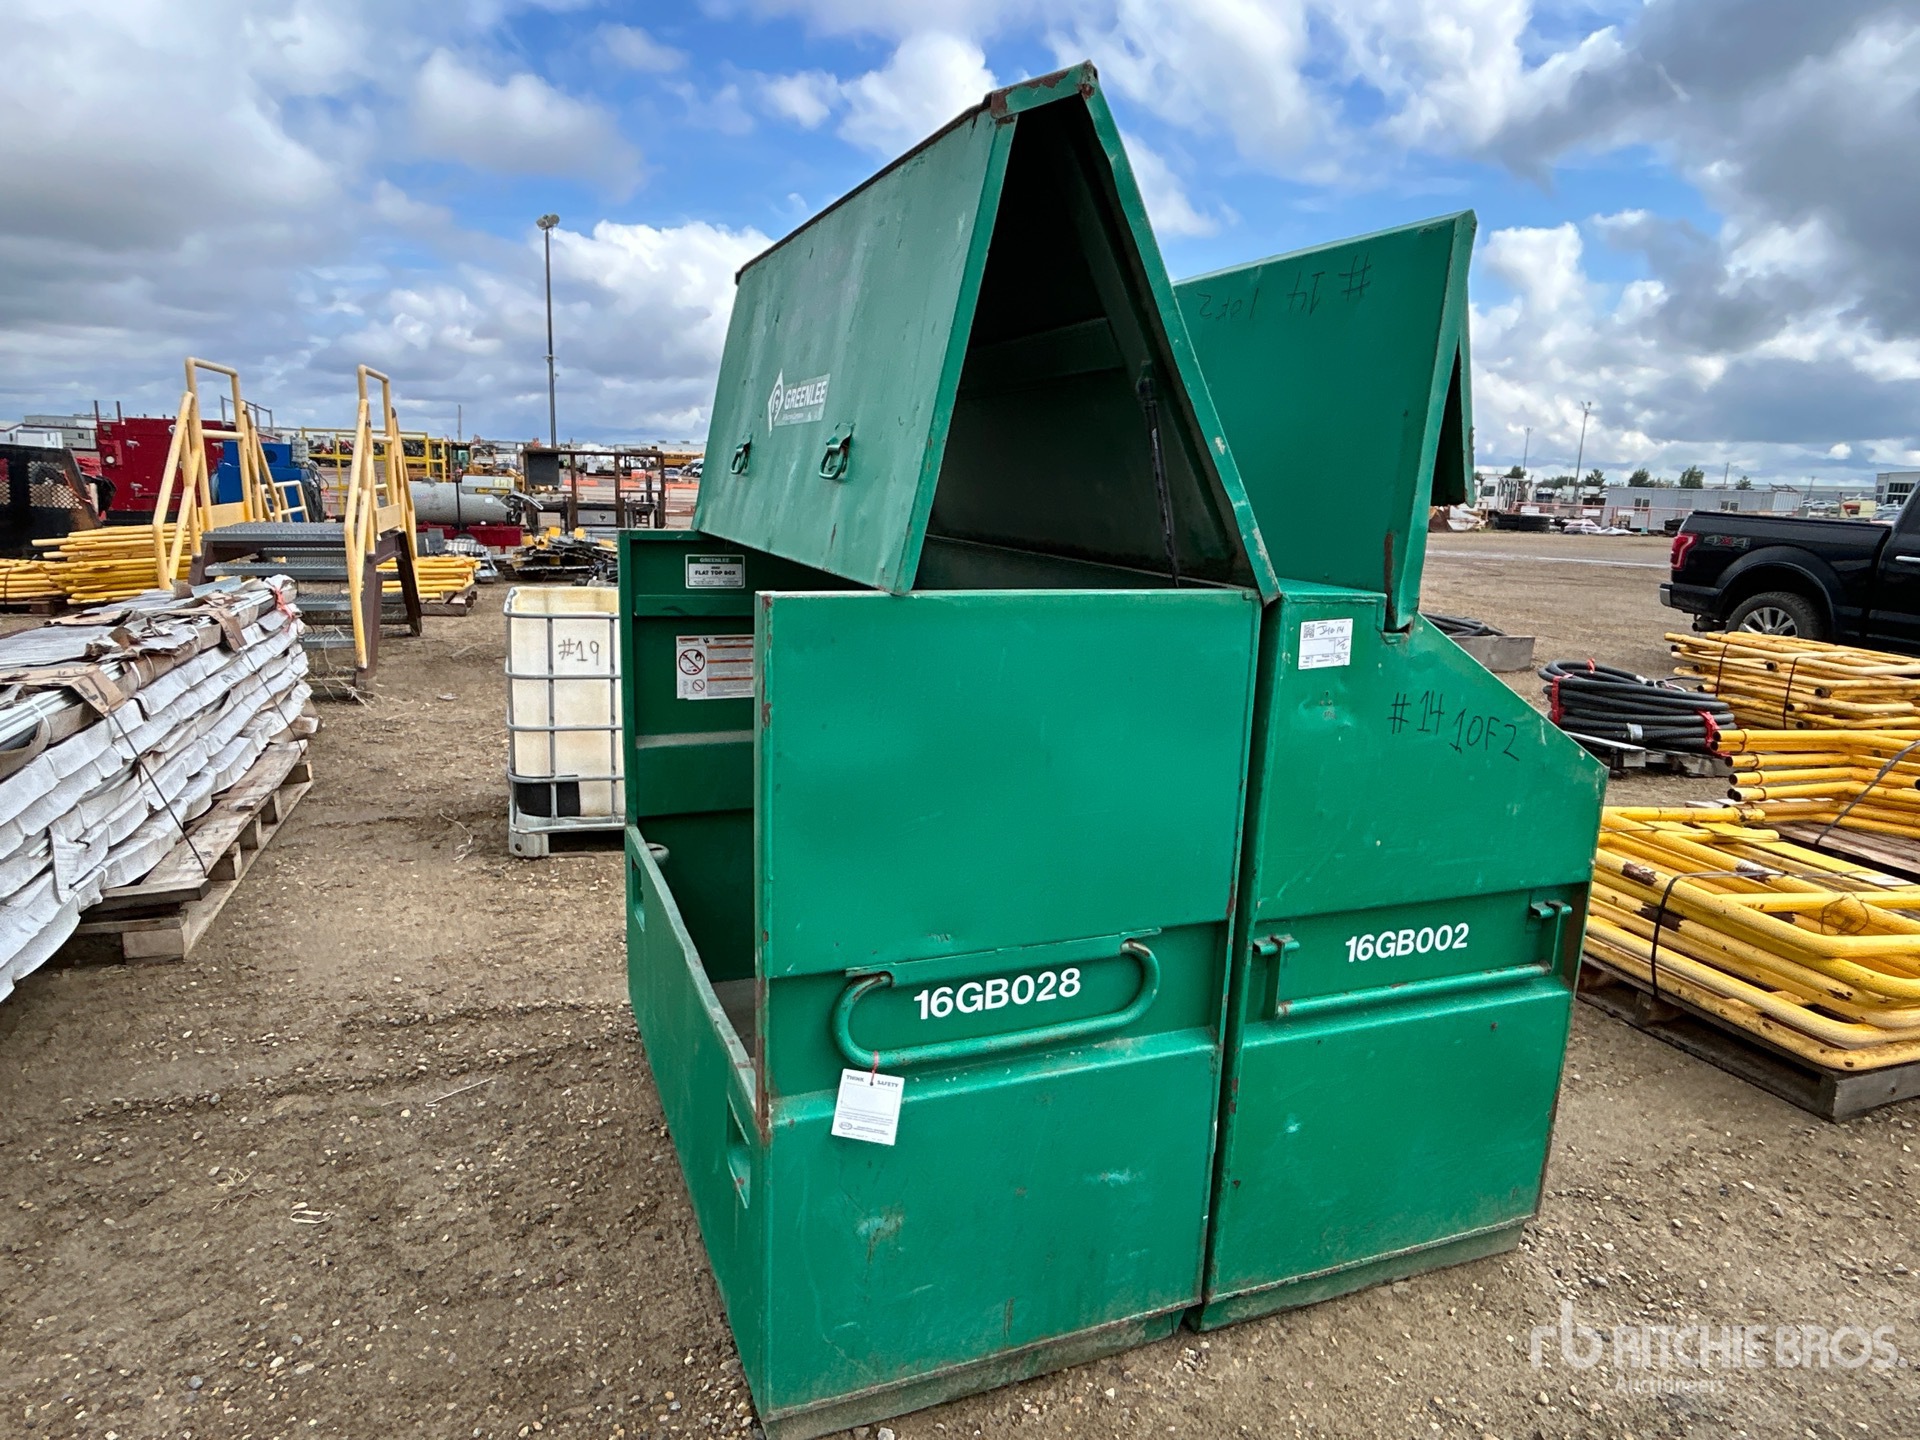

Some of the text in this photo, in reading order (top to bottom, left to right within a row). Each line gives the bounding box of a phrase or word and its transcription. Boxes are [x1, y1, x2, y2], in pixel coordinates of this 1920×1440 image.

[784, 380, 828, 411] GREENLEE
[557, 637, 600, 667] #19
[1387, 690, 1445, 735] #14
[1345, 922, 1470, 963] 16GB002
[913, 967, 1082, 1020] 16GB028
[846, 1074, 899, 1088] THINK SAFETY
